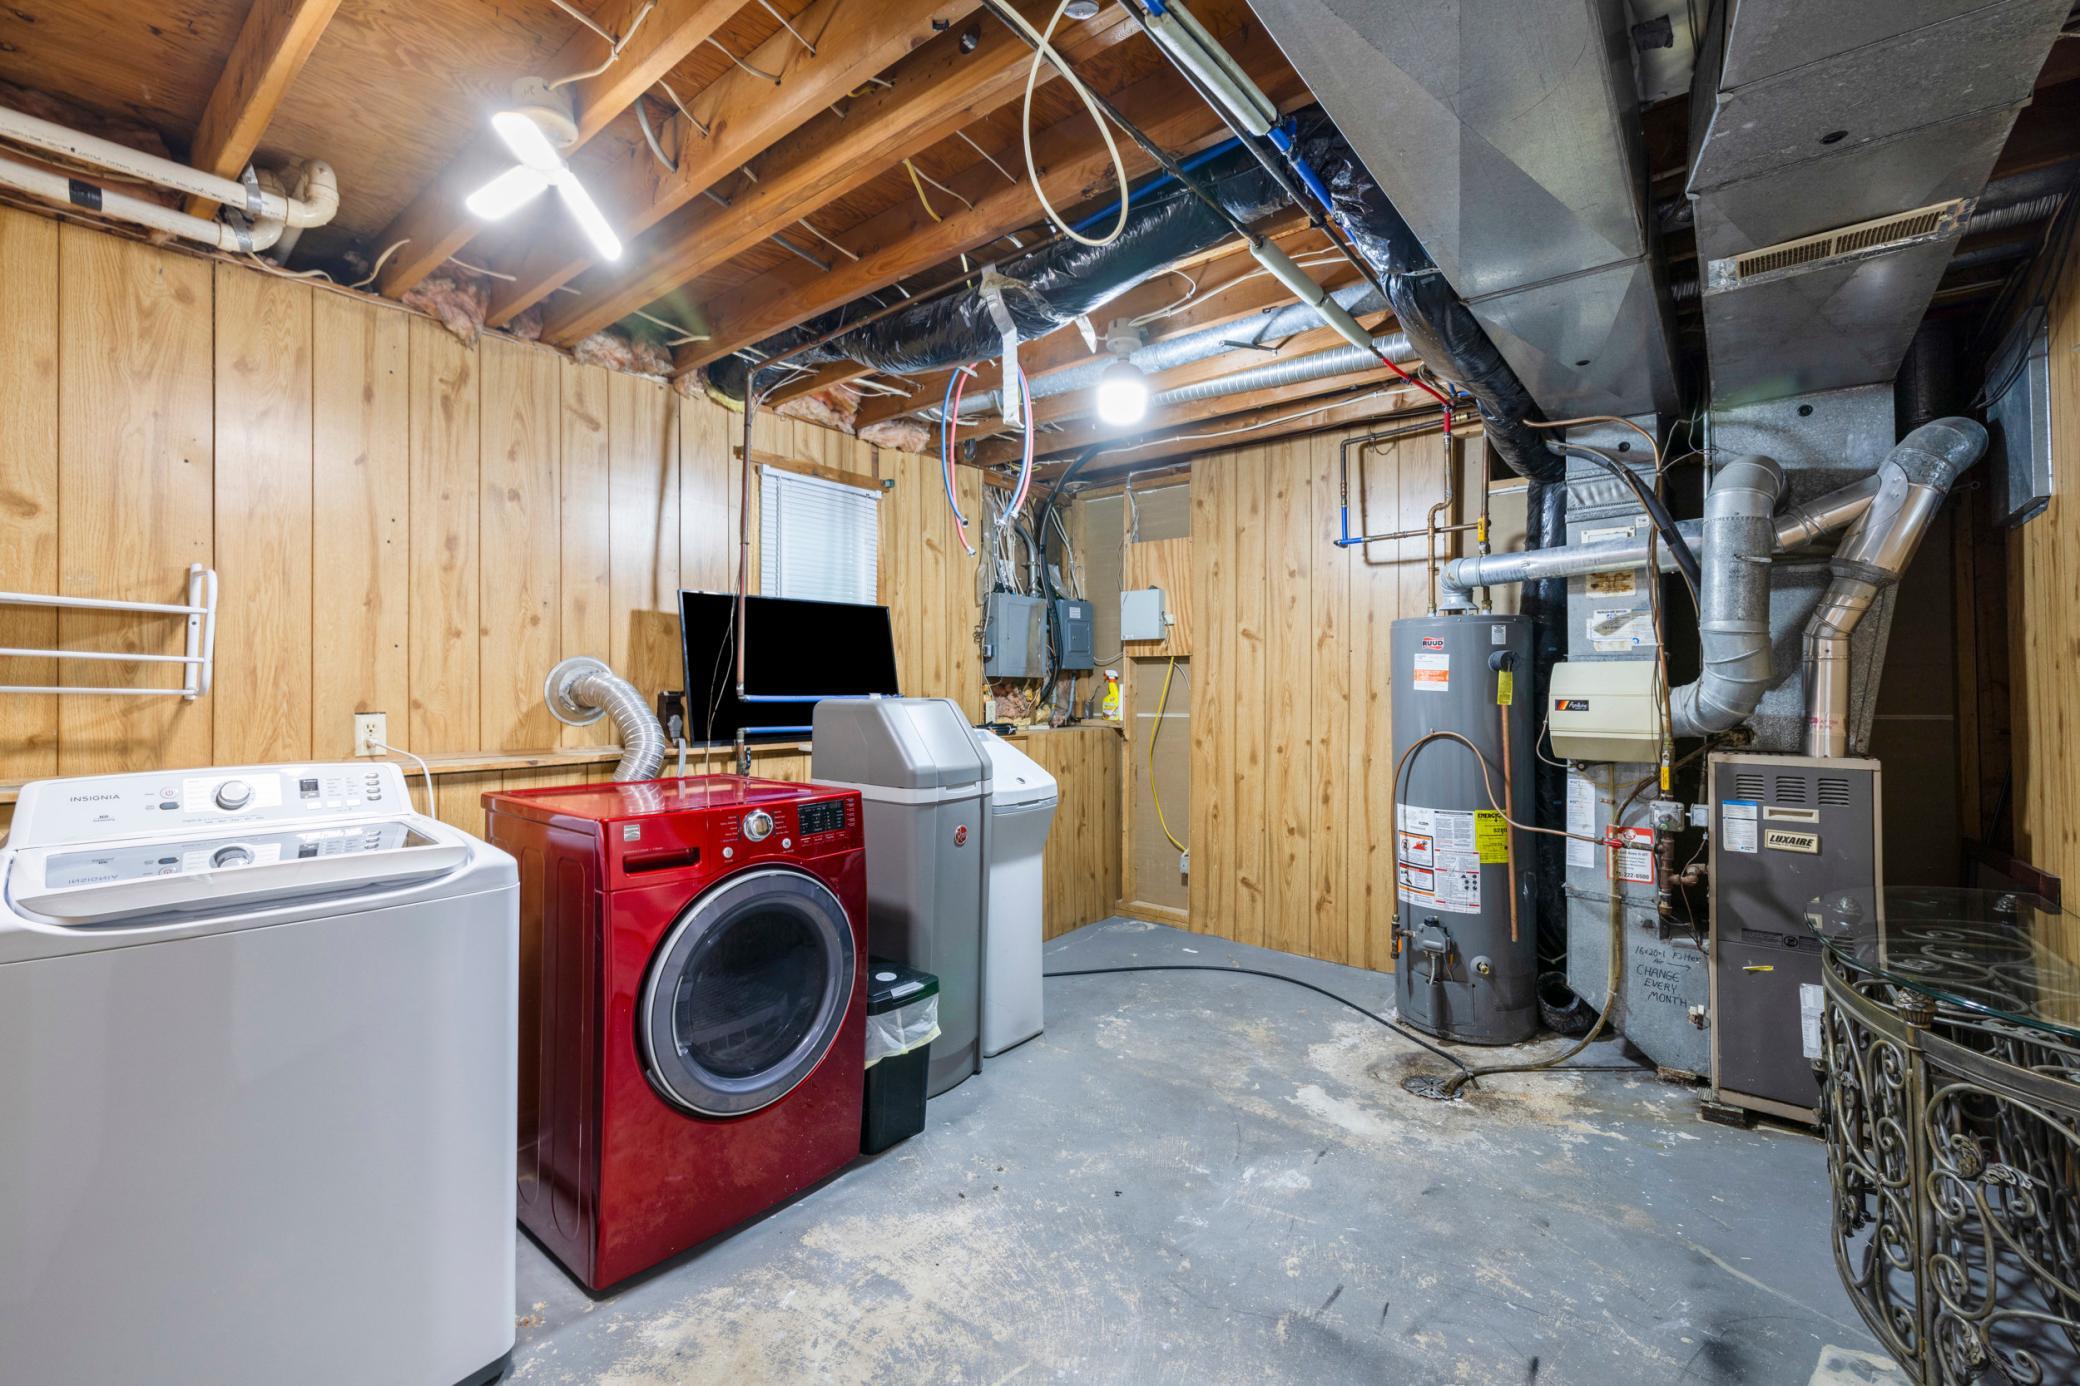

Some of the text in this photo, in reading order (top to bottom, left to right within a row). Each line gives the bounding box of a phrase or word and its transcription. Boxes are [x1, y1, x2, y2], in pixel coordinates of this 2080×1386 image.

[1769, 834, 1814, 847] LUXAIRE
[1636, 964, 1680, 982] CHANGE
[1644, 977, 1678, 994] EVERY
[1648, 991, 1688, 1008] MONTH
